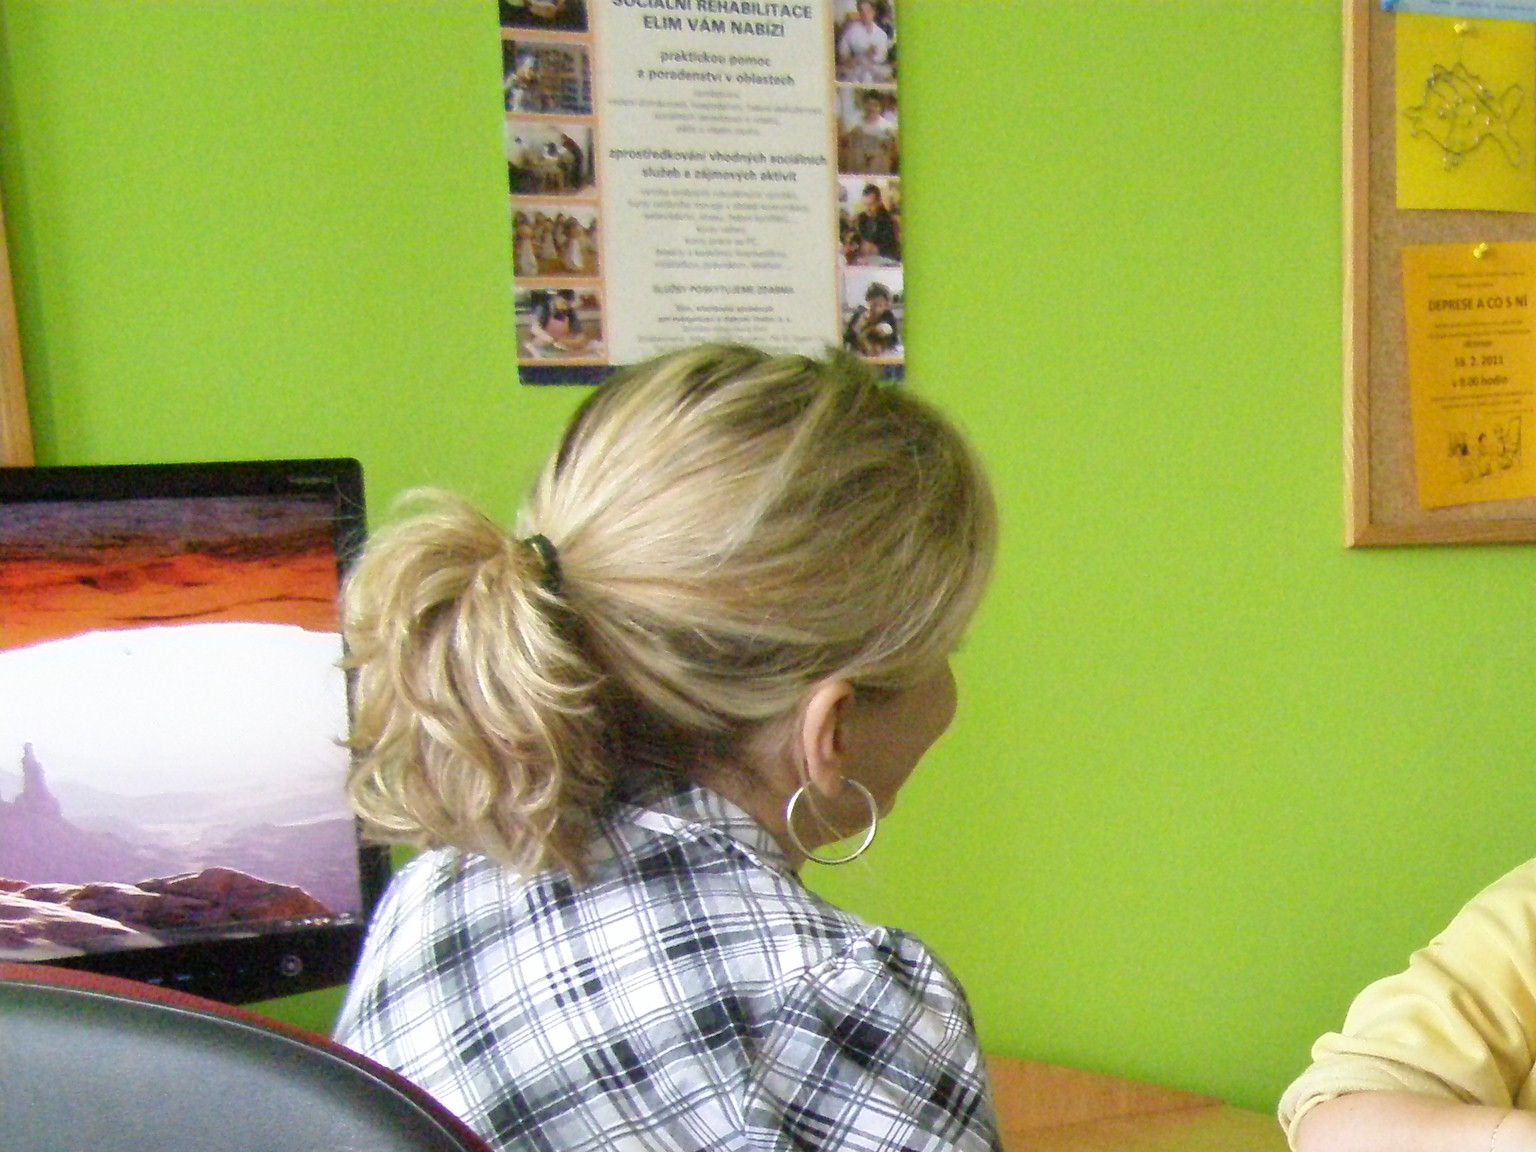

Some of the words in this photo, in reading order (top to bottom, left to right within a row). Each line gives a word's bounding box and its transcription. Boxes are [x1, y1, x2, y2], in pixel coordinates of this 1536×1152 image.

[697, 0, 812, 19] REHABILITACE
[643, 15, 682, 30] ELIM
[730, 54, 771, 67] pomoc
[736, 73, 795, 86] oblastech
[1428, 298, 1473, 312] DEPRESE
[1477, 297, 1484, 309] A
[1486, 296, 1503, 309] CO
[1506, 296, 1512, 309] S
